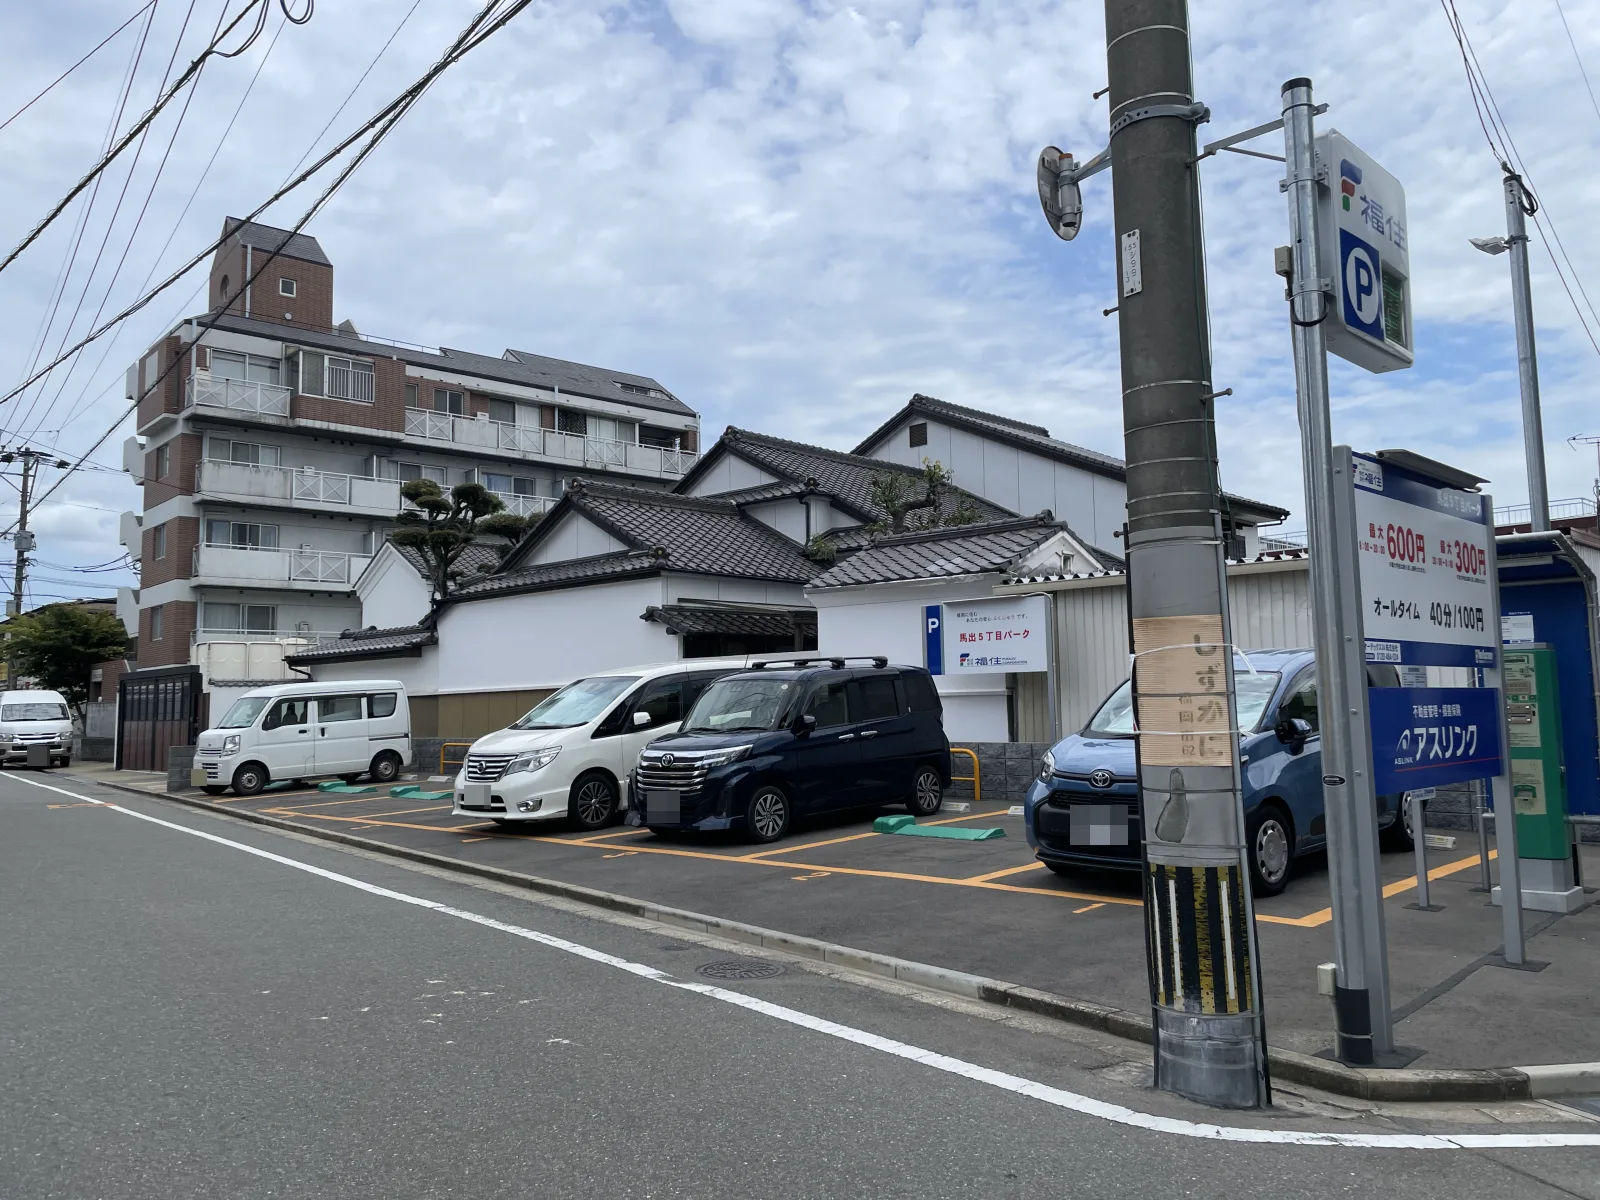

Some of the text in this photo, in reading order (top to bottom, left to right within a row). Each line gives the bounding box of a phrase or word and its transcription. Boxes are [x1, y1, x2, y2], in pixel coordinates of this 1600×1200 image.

[1360, 194, 1406, 252] 福住
[1354, 255, 1373, 312] P
[1369, 522, 1425, 564] 最大 600円
[1454, 540, 1486, 576] 300円
[928, 618, 939, 633] P
[1373, 597, 1421, 620] オールタイム
[1429, 601, 1485, 632] 40分/100円
[959, 629, 1031, 643] 馬出5丁目パーク
[974, 656, 1002, 666] 福住
[1394, 756, 1413, 765] ASLINK
[1413, 725, 1477, 761] アスリンク
